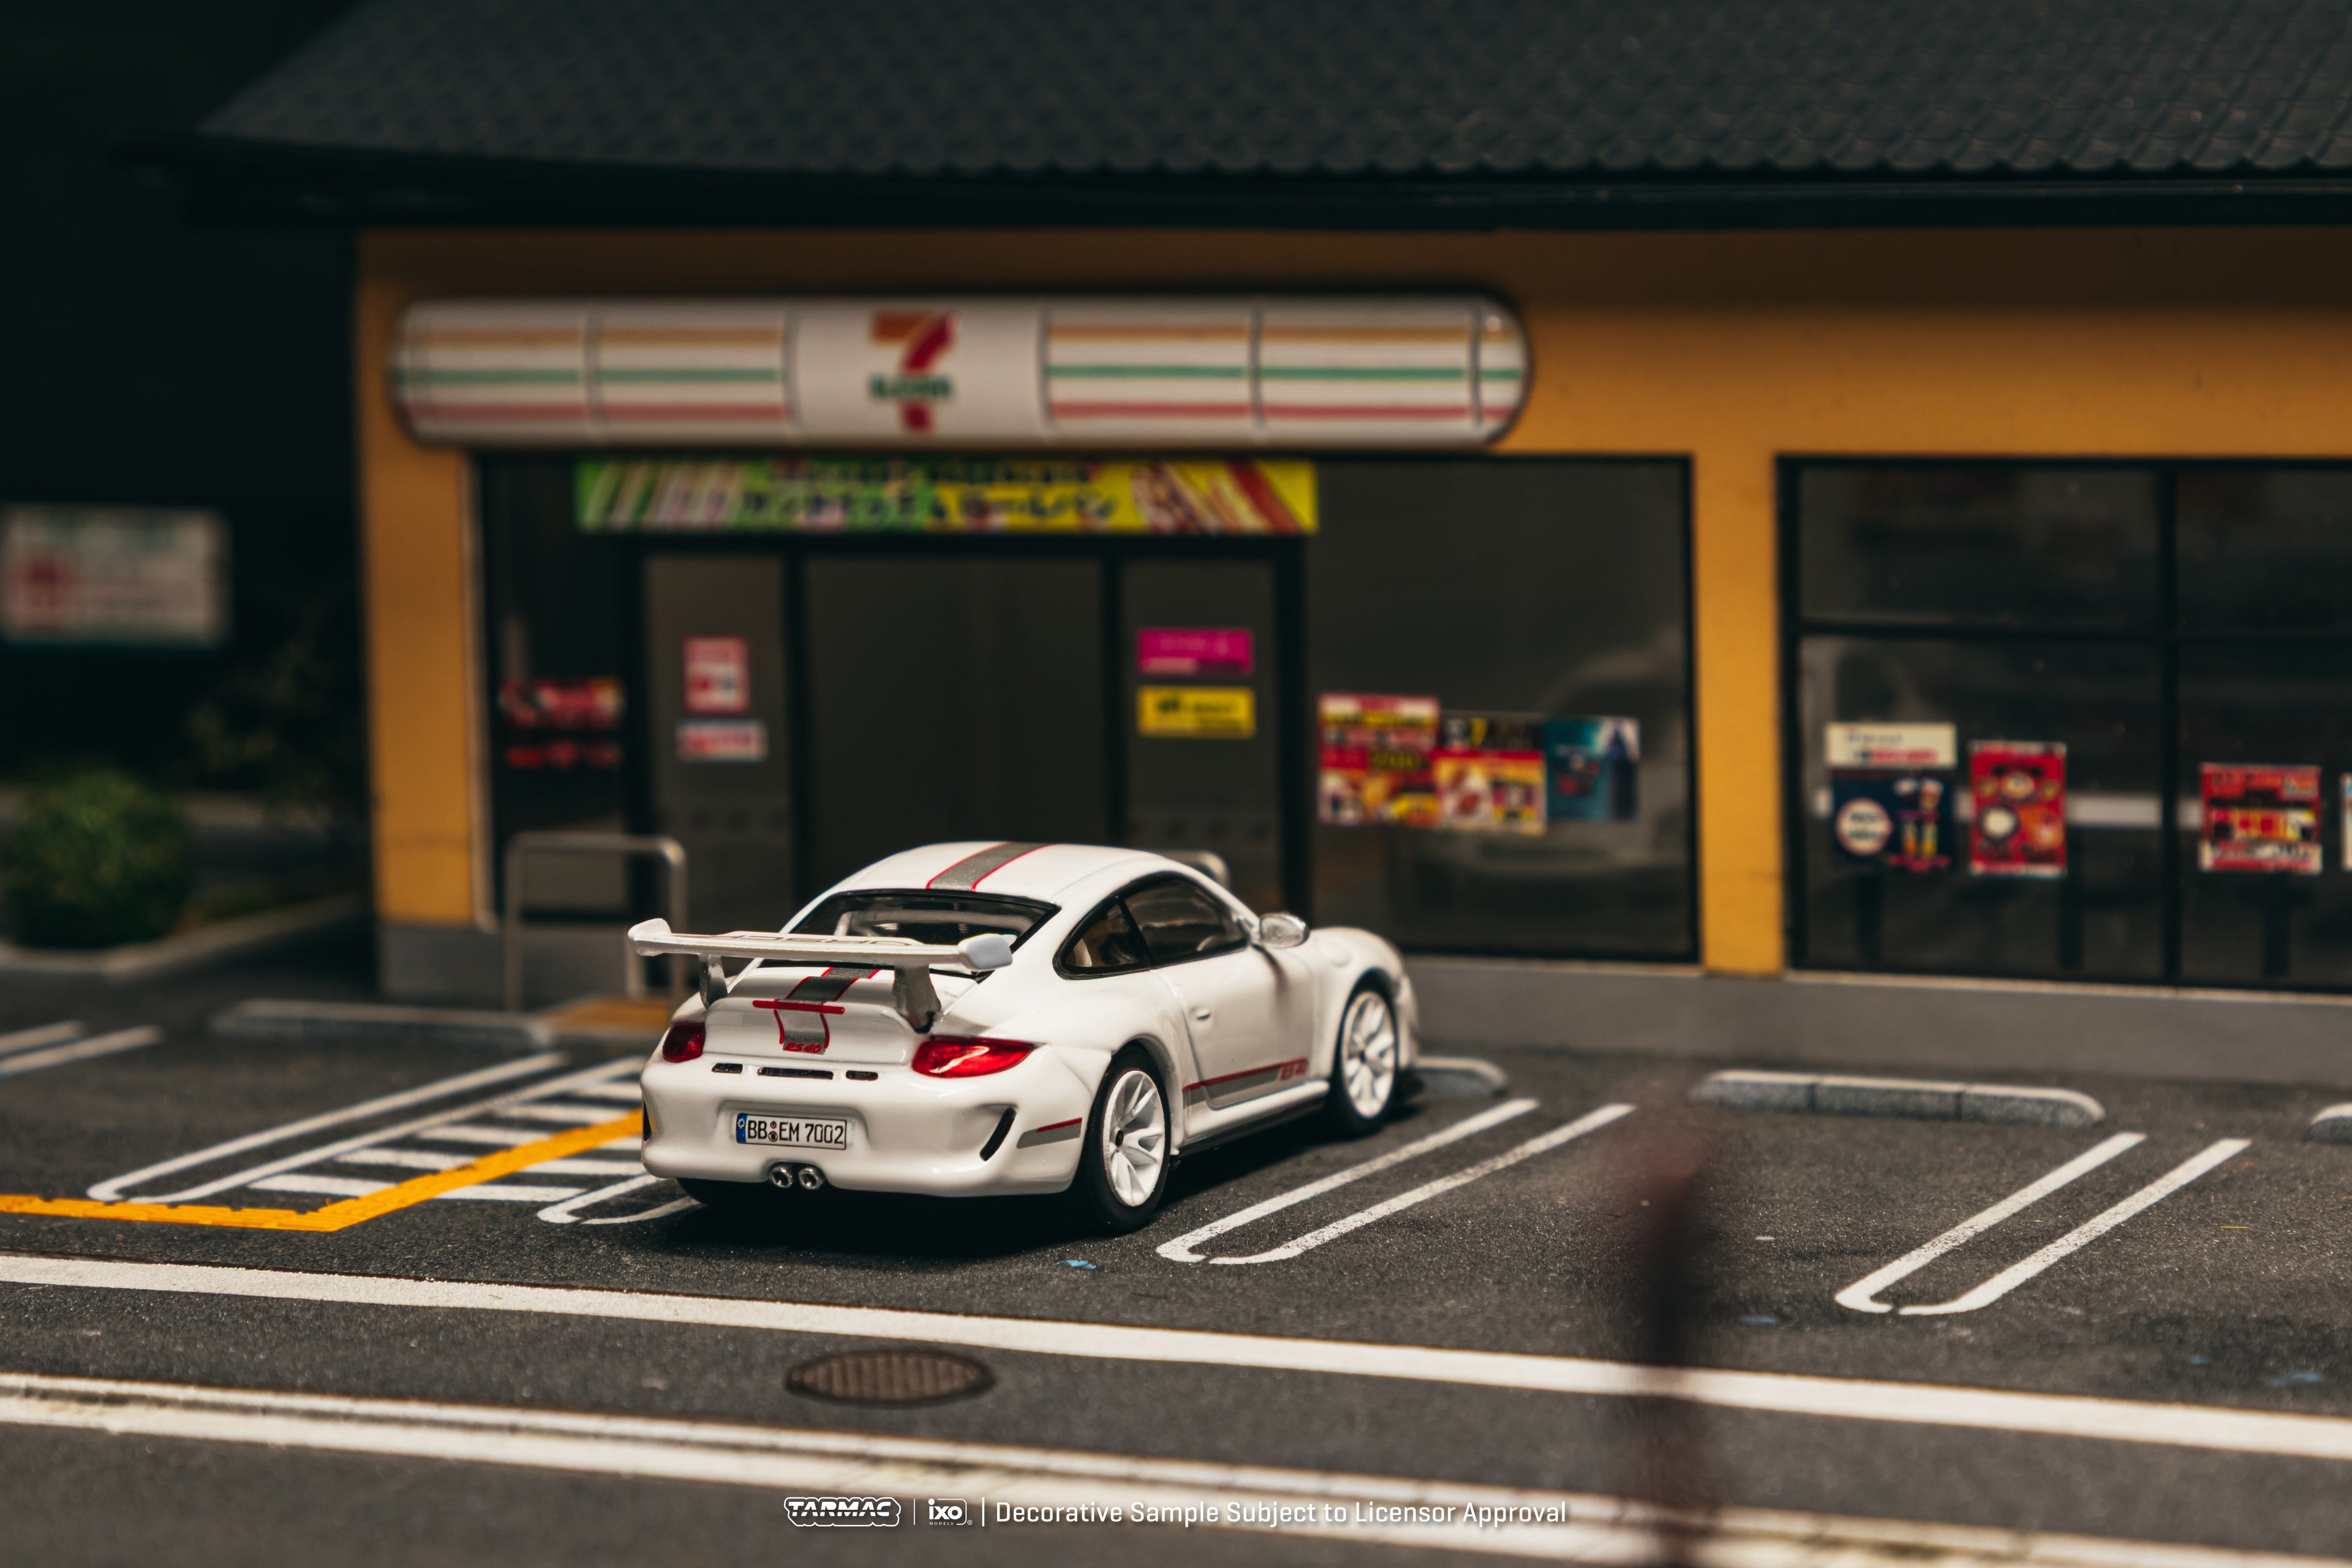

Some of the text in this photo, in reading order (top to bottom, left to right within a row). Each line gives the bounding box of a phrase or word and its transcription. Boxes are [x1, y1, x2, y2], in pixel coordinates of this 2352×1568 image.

[747, 1120, 845, 1145] BB EM 7002
